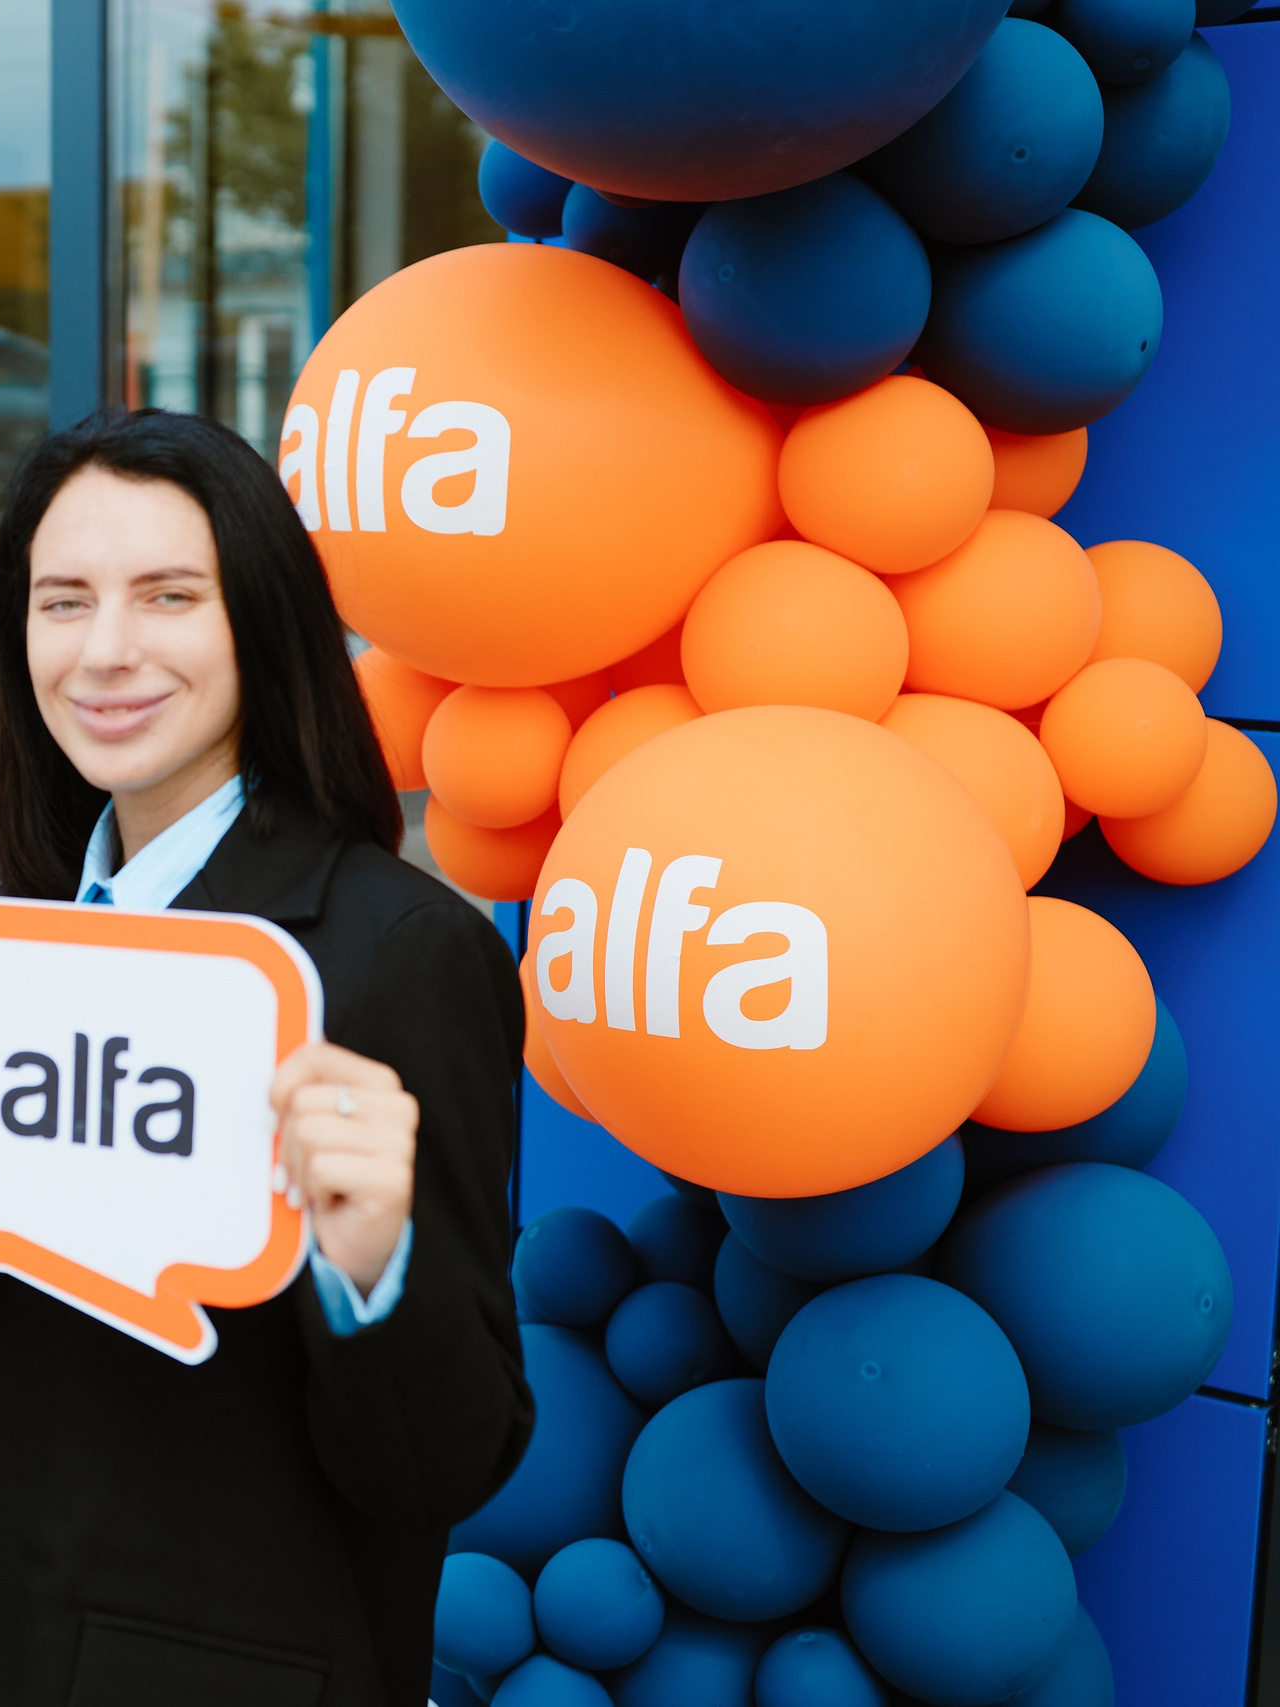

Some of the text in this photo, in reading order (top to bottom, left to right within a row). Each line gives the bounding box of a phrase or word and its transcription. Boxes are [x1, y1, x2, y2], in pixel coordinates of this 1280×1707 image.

[279, 366, 512, 537] alfa
[536, 846, 829, 1051] alfa
[0, 1032, 195, 1158] alfa
